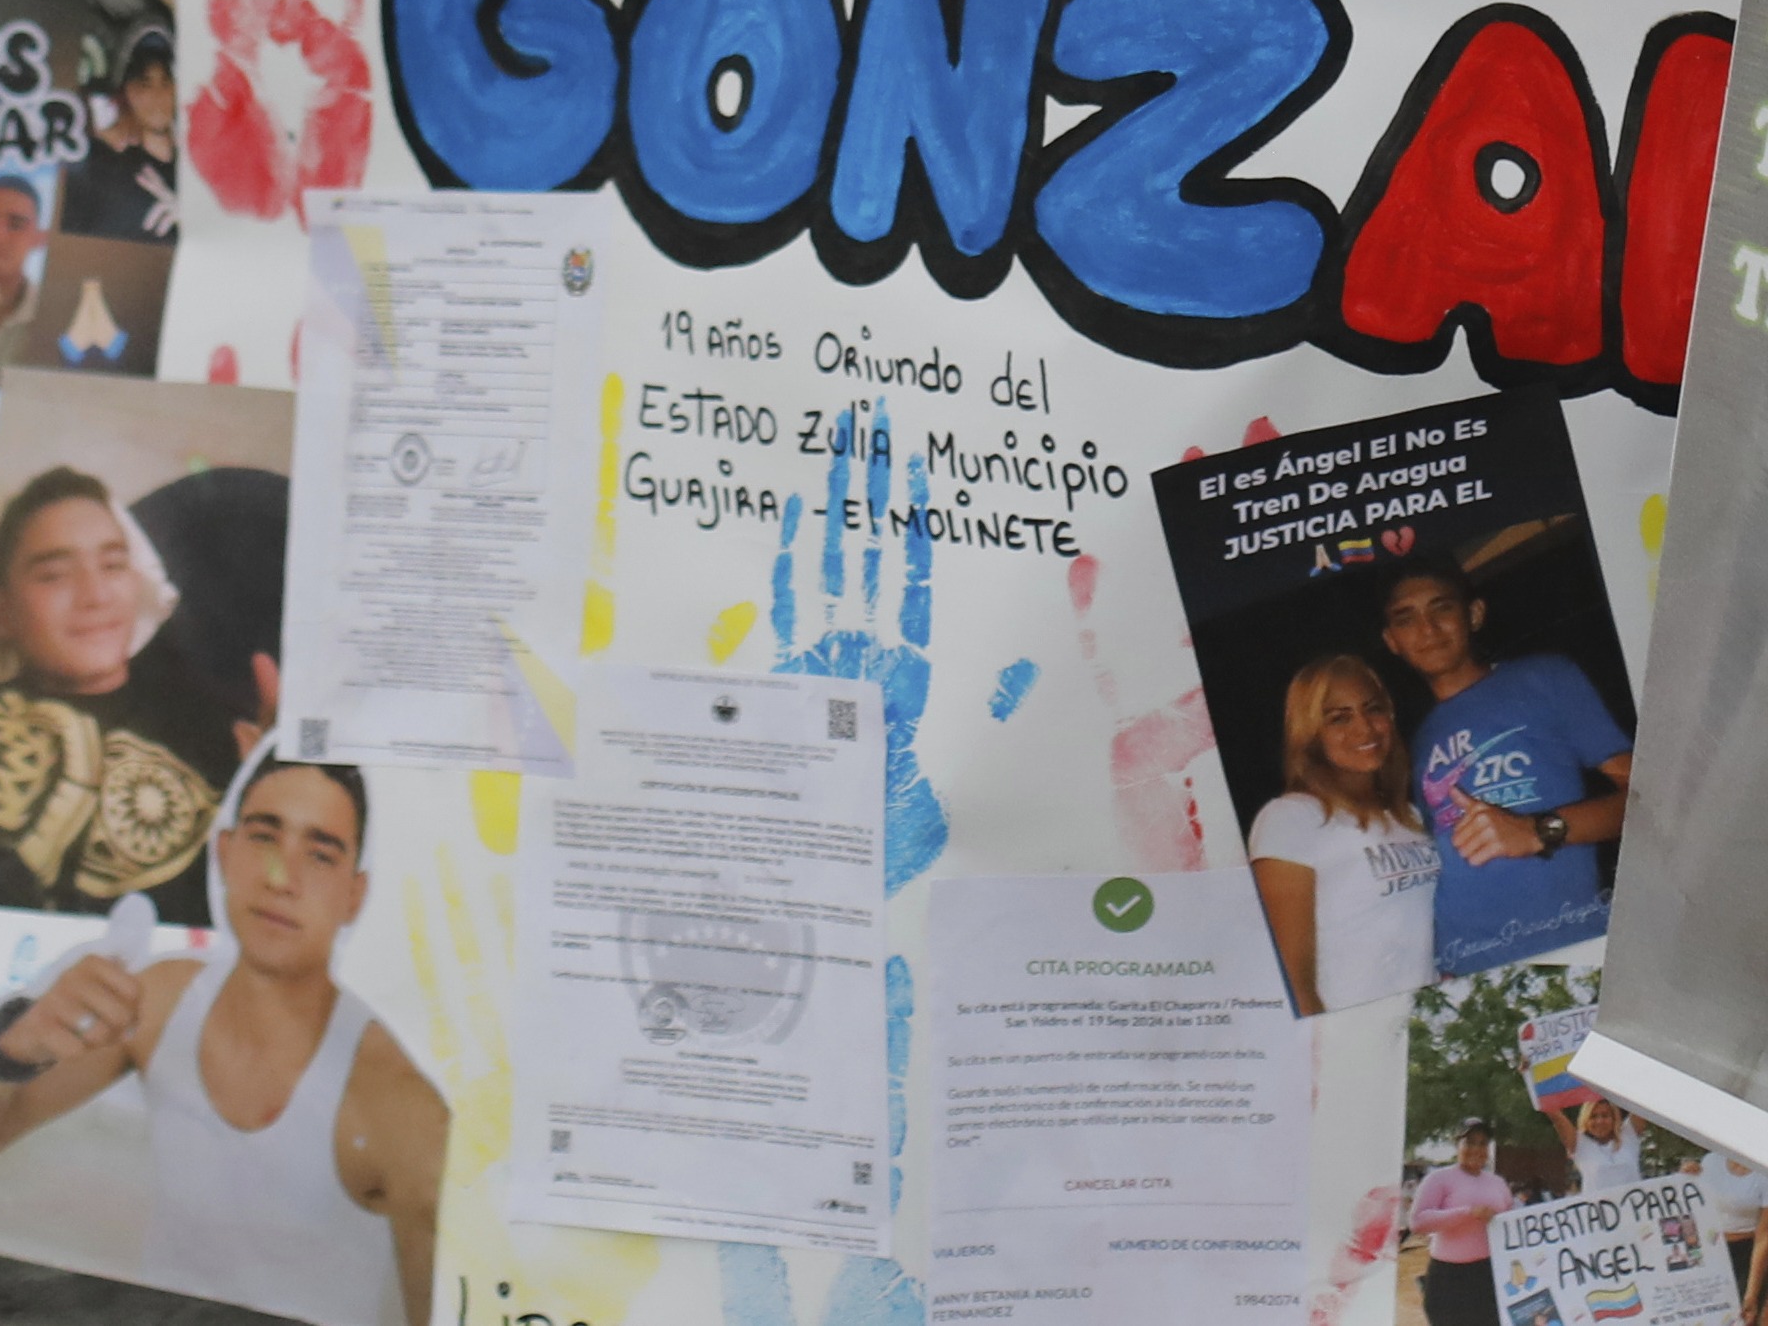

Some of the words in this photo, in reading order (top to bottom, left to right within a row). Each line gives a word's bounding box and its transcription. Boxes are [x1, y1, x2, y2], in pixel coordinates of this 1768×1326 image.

[662, 311, 693, 351] 19
[928, 430, 1128, 510] Municipio
[1199, 472, 1226, 501] El
[1233, 464, 1267, 493] es
[1274, 441, 1361, 488] Ángel
[1370, 434, 1397, 460] El
[1405, 427, 1446, 455] No
[1454, 417, 1489, 443] Es
[1233, 492, 1301, 524] Tren
[1308, 476, 1349, 506] De
[1356, 455, 1468, 498] Aragua
[1223, 499, 1358, 562] JUSTICIA
[1364, 488, 1449, 527] PARA
[1456, 478, 1492, 506] EL
[1429, 729, 1475, 772] AIR
[1027, 960, 1070, 976] CITA
[1074, 960, 1216, 978] PROGRAMADA
[1064, 1178, 1138, 1192] CANCELAR
[1141, 1177, 1173, 1190] CITA
[1503, 1198, 1621, 1251] LIBERTAD
[1622, 1182, 1706, 1223] PARA
[1557, 1242, 1655, 1290] ANGEL
